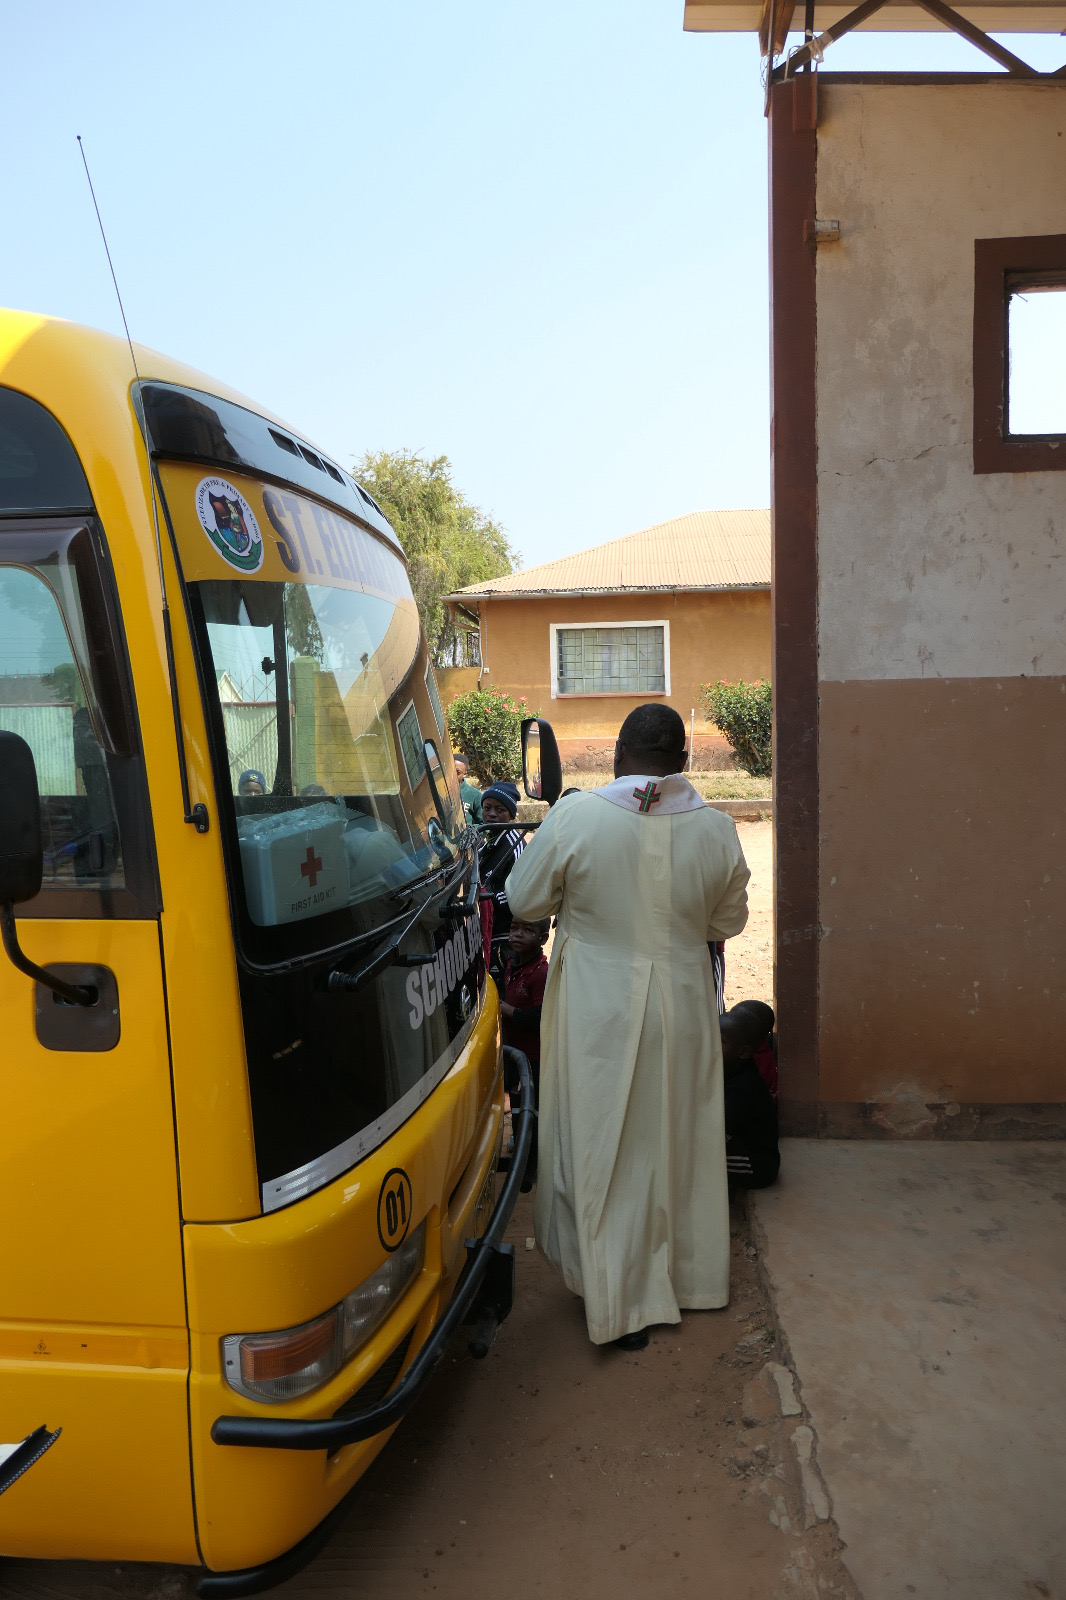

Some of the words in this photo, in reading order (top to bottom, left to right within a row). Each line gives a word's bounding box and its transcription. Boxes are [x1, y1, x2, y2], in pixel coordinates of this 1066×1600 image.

[262, 490, 324, 575] ST.
[291, 896, 312, 914] FIRST
[313, 891, 325, 904] AID
[325, 886, 336, 898] KIT
[405, 925, 469, 1030] SCHOOL
[385, 1180, 407, 1237] 01
